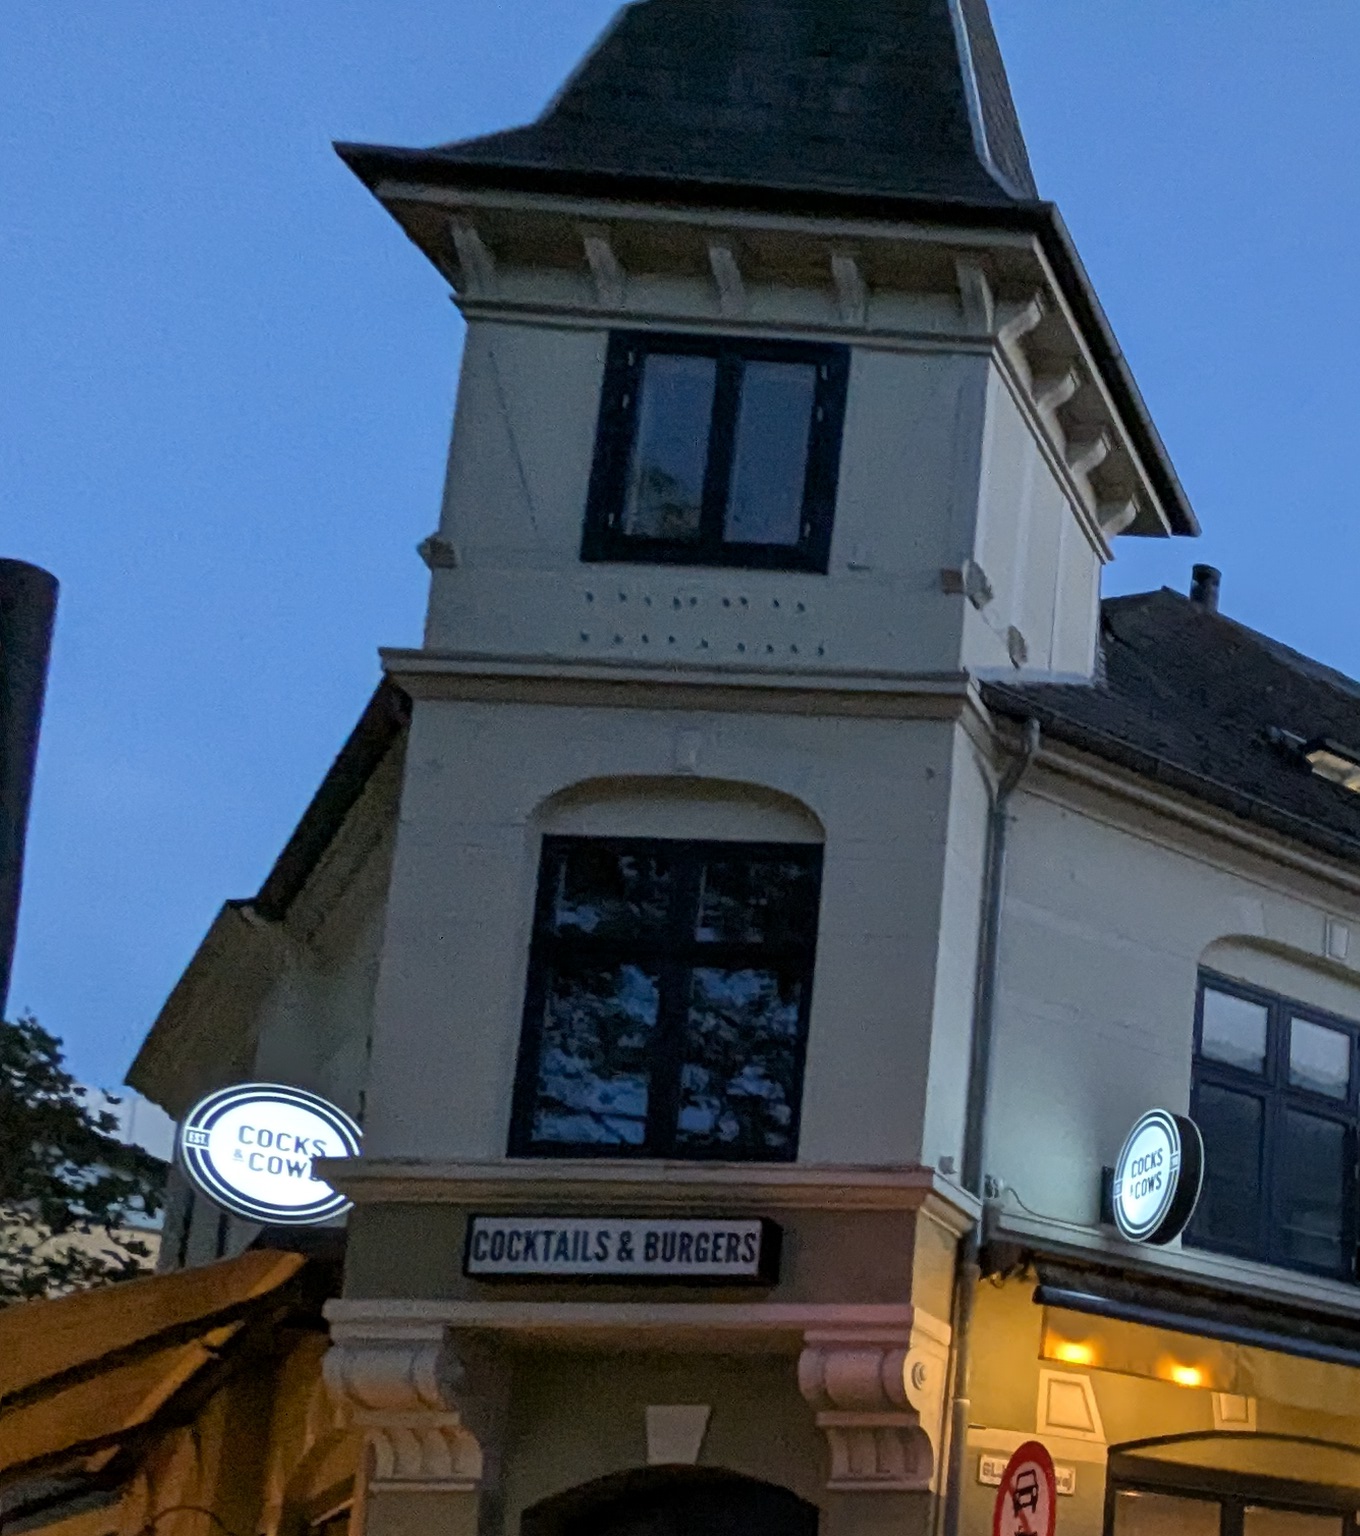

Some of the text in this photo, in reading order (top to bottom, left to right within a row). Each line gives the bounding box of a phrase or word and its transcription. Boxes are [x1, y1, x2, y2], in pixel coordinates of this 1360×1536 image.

[238, 1125, 327, 1157] COCKS
[249, 1152, 322, 1182] COW
[1131, 1147, 1163, 1178] COCKS
[1135, 1171, 1162, 1200] COWS
[472, 1229, 757, 1263] COCKTAILS & BURGERS
